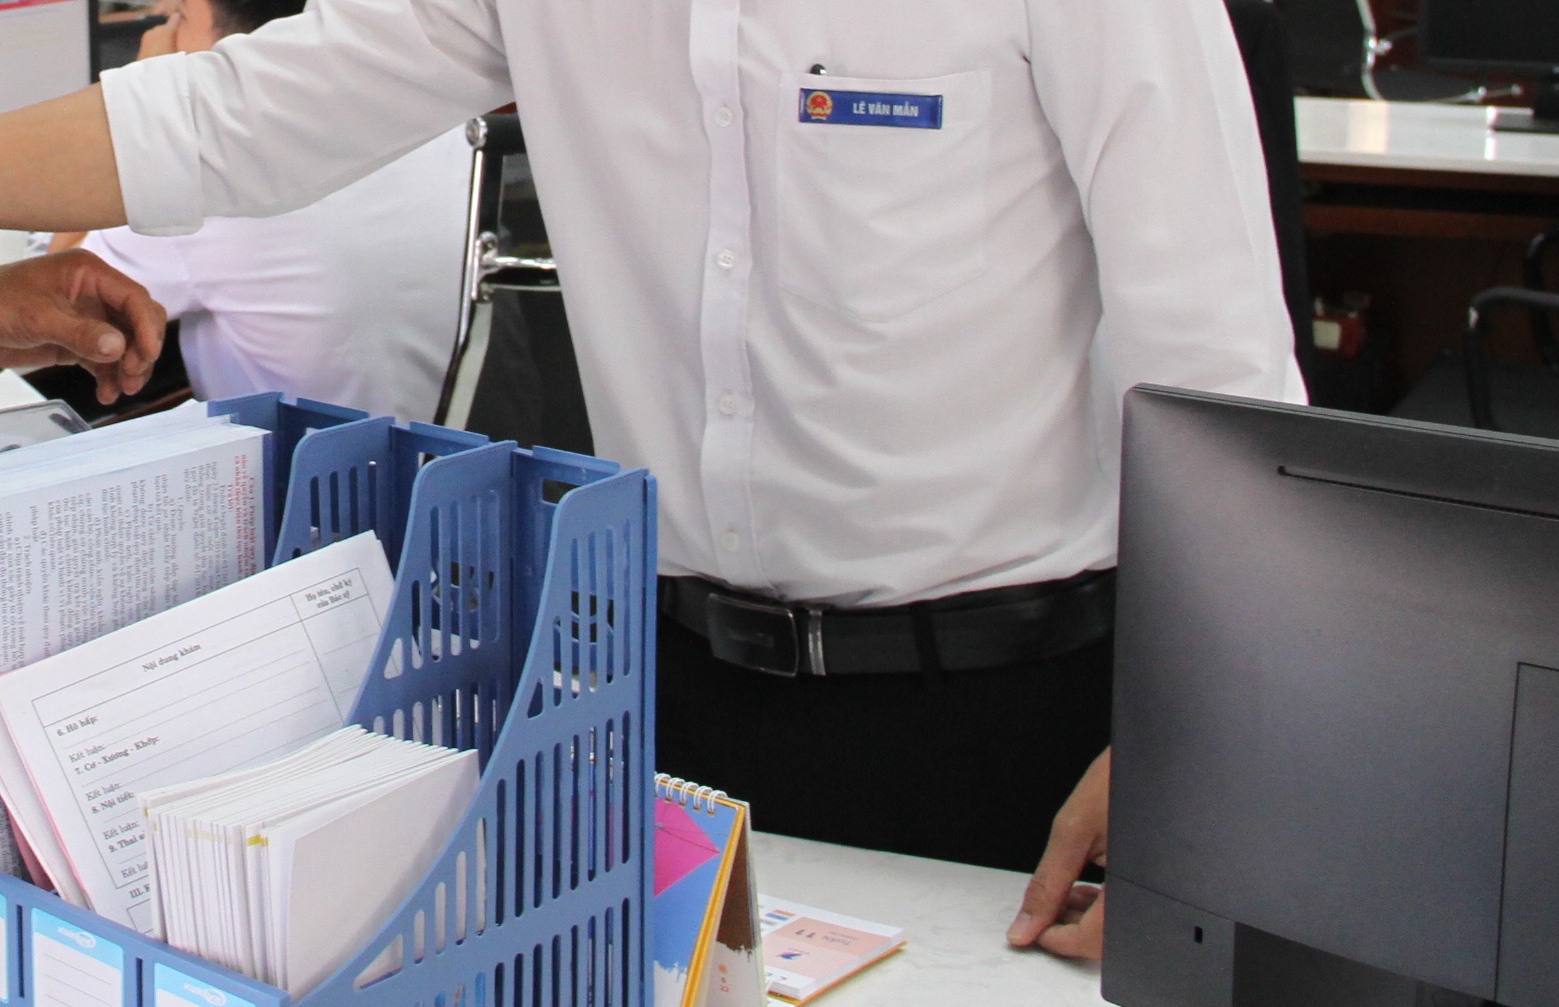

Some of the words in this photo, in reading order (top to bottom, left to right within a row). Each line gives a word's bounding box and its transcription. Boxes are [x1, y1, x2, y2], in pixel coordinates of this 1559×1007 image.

[868, 101, 890, 115] VĂN
[305, 593, 317, 602] Họ
[142, 661, 158, 672] Nội
[158, 653, 179, 666] dung
[178, 644, 201, 657] khám
[65, 723, 79, 733] Hô
[78, 716, 98, 727] hấp:
[68, 751, 85, 763] Kết
[85, 744, 106, 756] luận:
[84, 761, 97, 771] Cơ
[101, 749, 130, 764] Xương
[133, 736, 160, 750] Khớp:
[85, 789, 102, 801] Kết
[101, 782, 122, 794] luận:
[100, 798, 116, 810] Nội
[116, 791, 135, 803] tiết:
[102, 827, 118, 840] Kết
[116, 835, 138, 848] Thai
[120, 866, 137, 878] Kết
